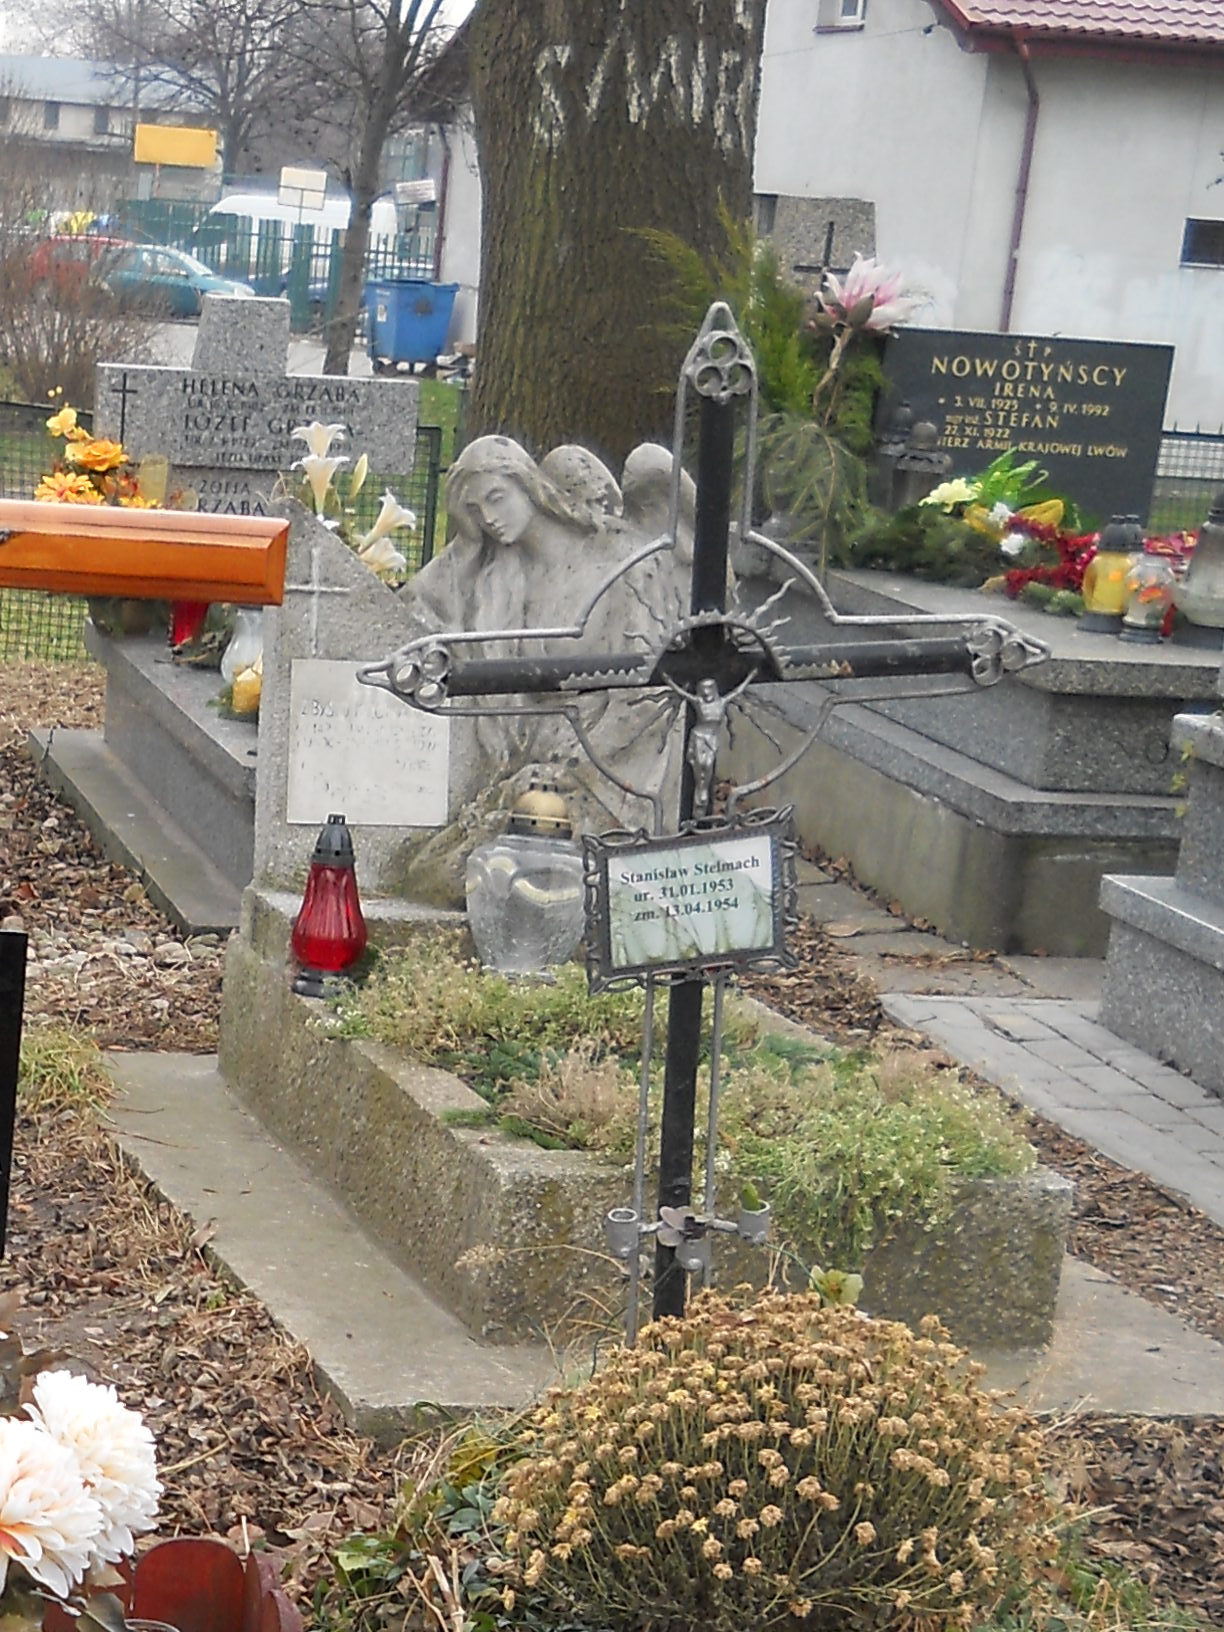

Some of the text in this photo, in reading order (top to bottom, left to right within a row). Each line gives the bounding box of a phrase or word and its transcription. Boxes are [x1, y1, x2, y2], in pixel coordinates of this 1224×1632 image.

[931, 355, 1126, 387] NOWOTYŃSCY
[182, 377, 360, 404] HELENA GRZABA
[993, 381, 1055, 399] IRENA
[984, 410, 1059, 428] STEFAN
[693, 855, 760, 877] Stelmach
[633, 878, 735, 903] ur. 31.01.1953
[633, 909, 661, 922] zm.
